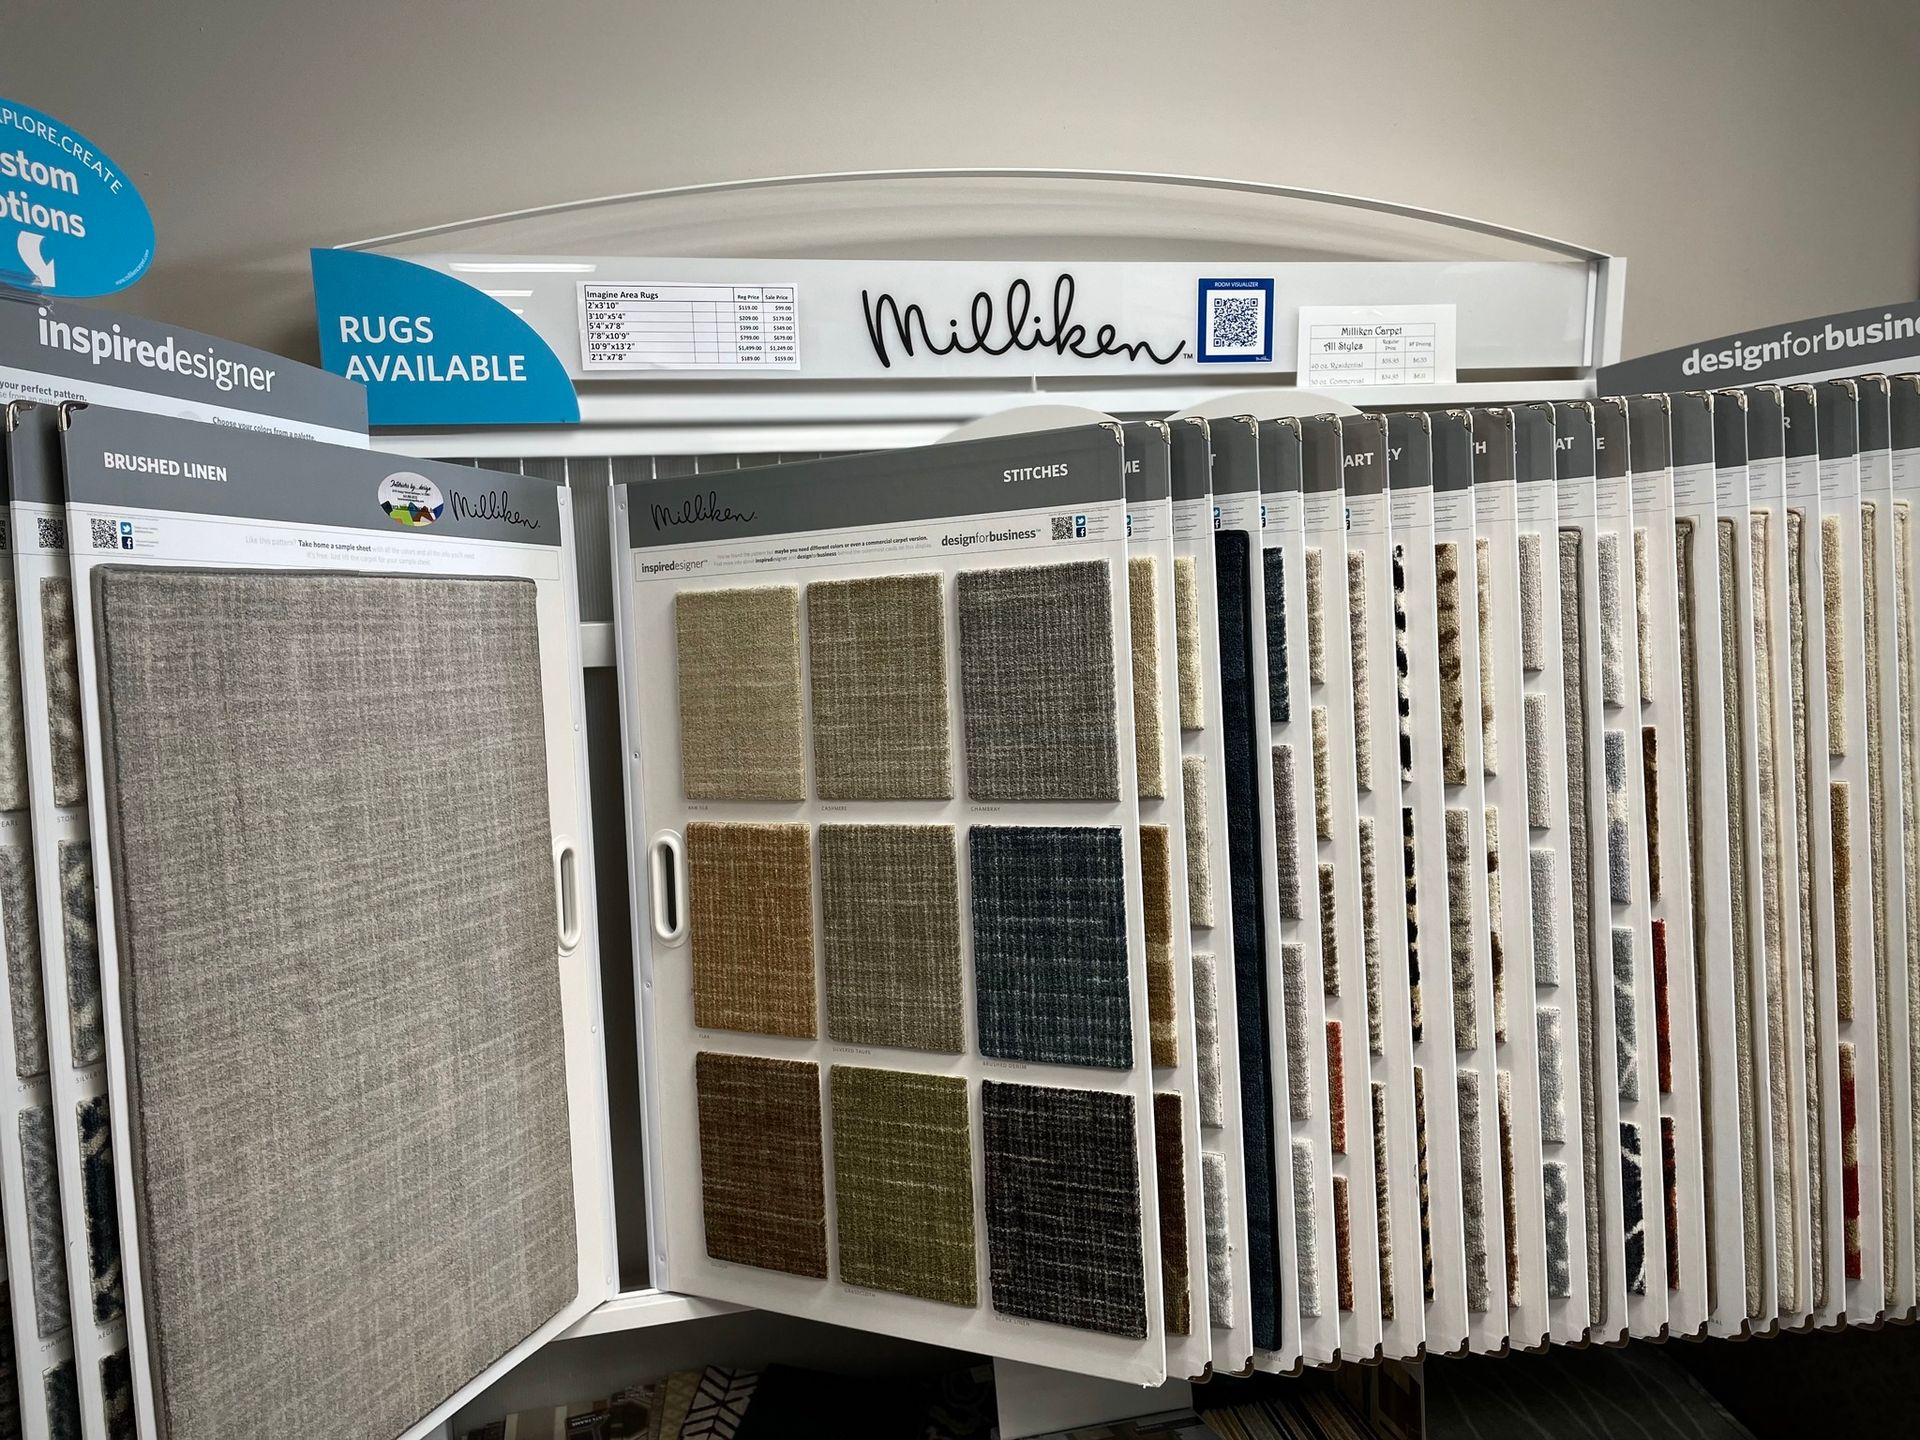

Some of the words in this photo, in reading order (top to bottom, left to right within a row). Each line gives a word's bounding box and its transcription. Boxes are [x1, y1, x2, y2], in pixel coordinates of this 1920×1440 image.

[0, 108, 123, 195] PLORE.CREATE
[587, 291, 618, 299] Imagine
[640, 292, 659, 300] Rugs
[339, 316, 434, 343] RUGS
[862, 273, 1186, 368] Milliken
[1341, 327, 1373, 336] Milliken
[1375, 326, 1403, 336] Carpet
[38, 307, 275, 393] inspiredesigner
[1324, 342, 1336, 352] All
[1338, 341, 1364, 352] Styles
[345, 355, 527, 382] AVAILABLE
[0, 381, 19, 390] your
[21, 384, 52, 396] perfect
[54, 390, 87, 401] pattern.
[212, 416, 237, 429] Choose
[238, 423, 252, 431] your
[254, 424, 273, 434] colors
[104, 452, 180, 476] BRUSHED
[183, 462, 228, 482] LINEN
[1003, 463, 1069, 483] STITCHES
[450, 490, 539, 529] Milliken
[650, 490, 755, 531] Milliken
[298, 540, 313, 548] Take
[314, 541, 330, 549] home
[336, 543, 356, 552] sample
[356, 544, 372, 552] sheet
[866, 538, 893, 546] commercial
[893, 537, 909, 545] carpet
